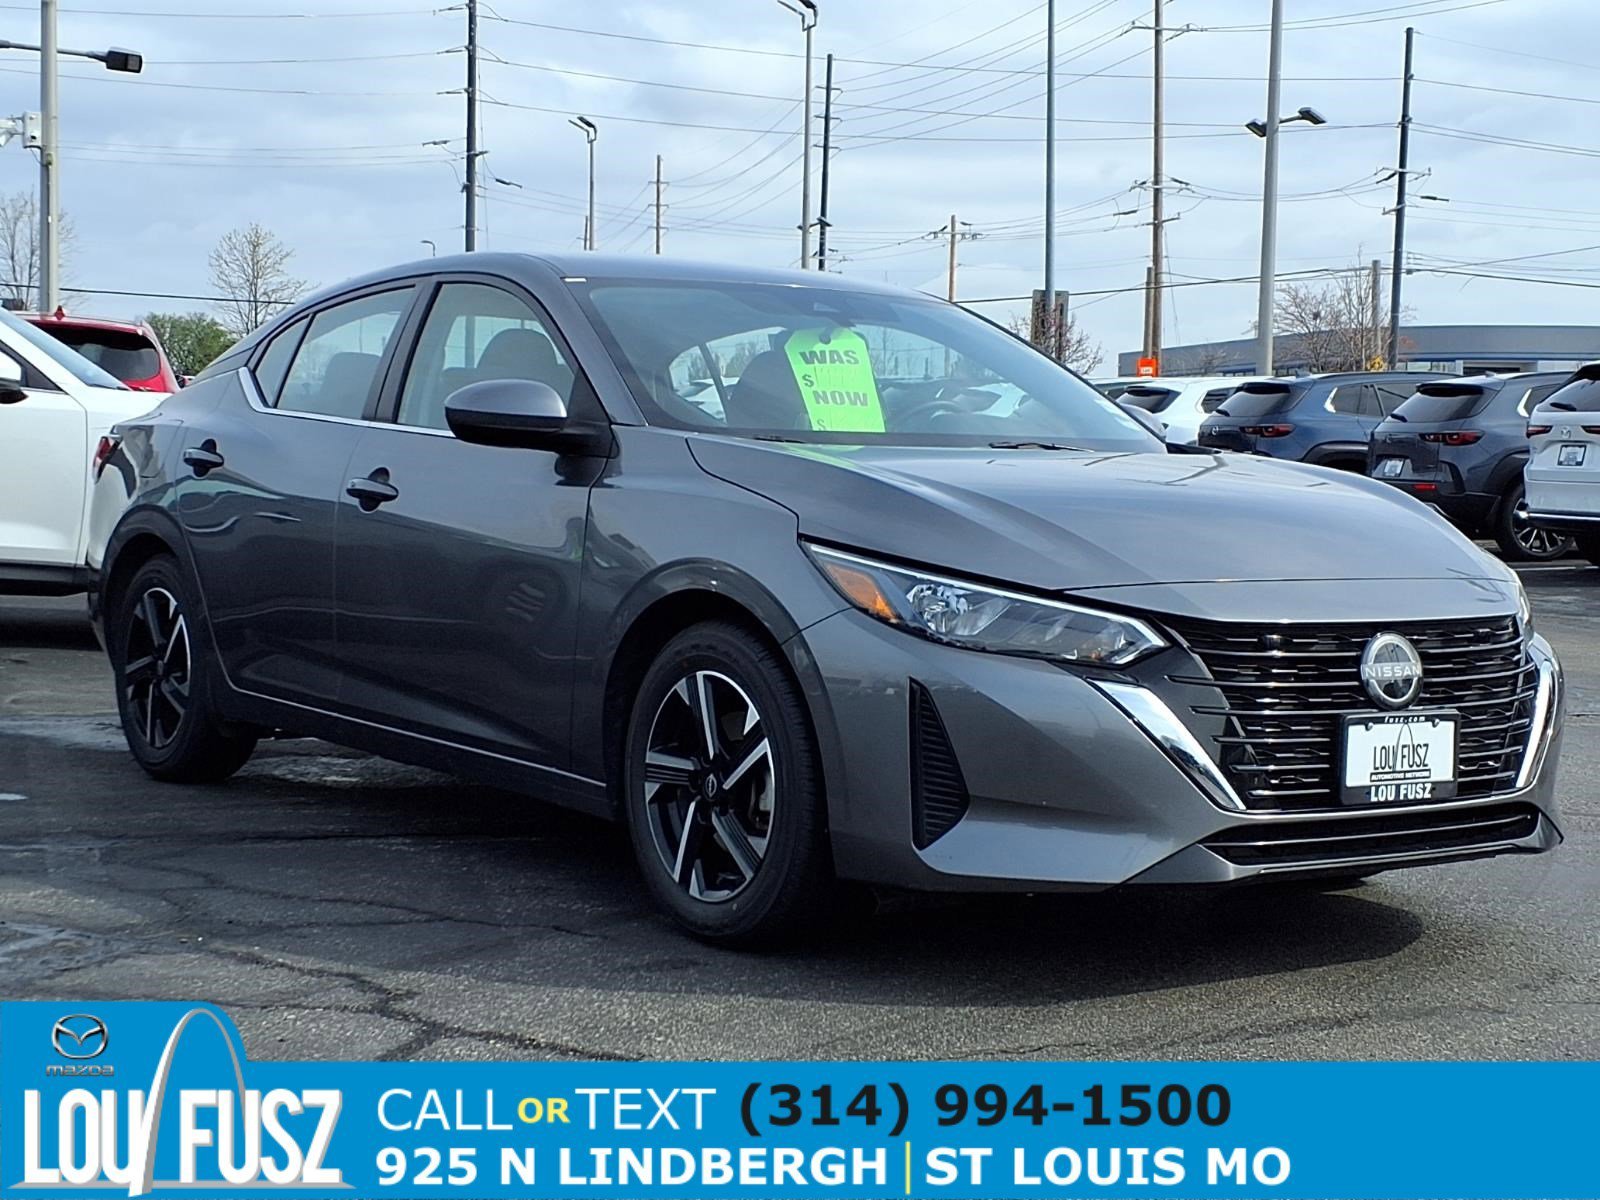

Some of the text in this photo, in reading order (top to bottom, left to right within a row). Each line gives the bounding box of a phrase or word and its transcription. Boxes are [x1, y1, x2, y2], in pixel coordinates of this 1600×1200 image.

[800, 350, 860, 365] WAS
[812, 390, 869, 407] NOW
[1363, 664, 1421, 678] NISSAN
[1373, 743, 1429, 770] LOU FUSZ
[1370, 782, 1432, 802] LOU FUSZ
